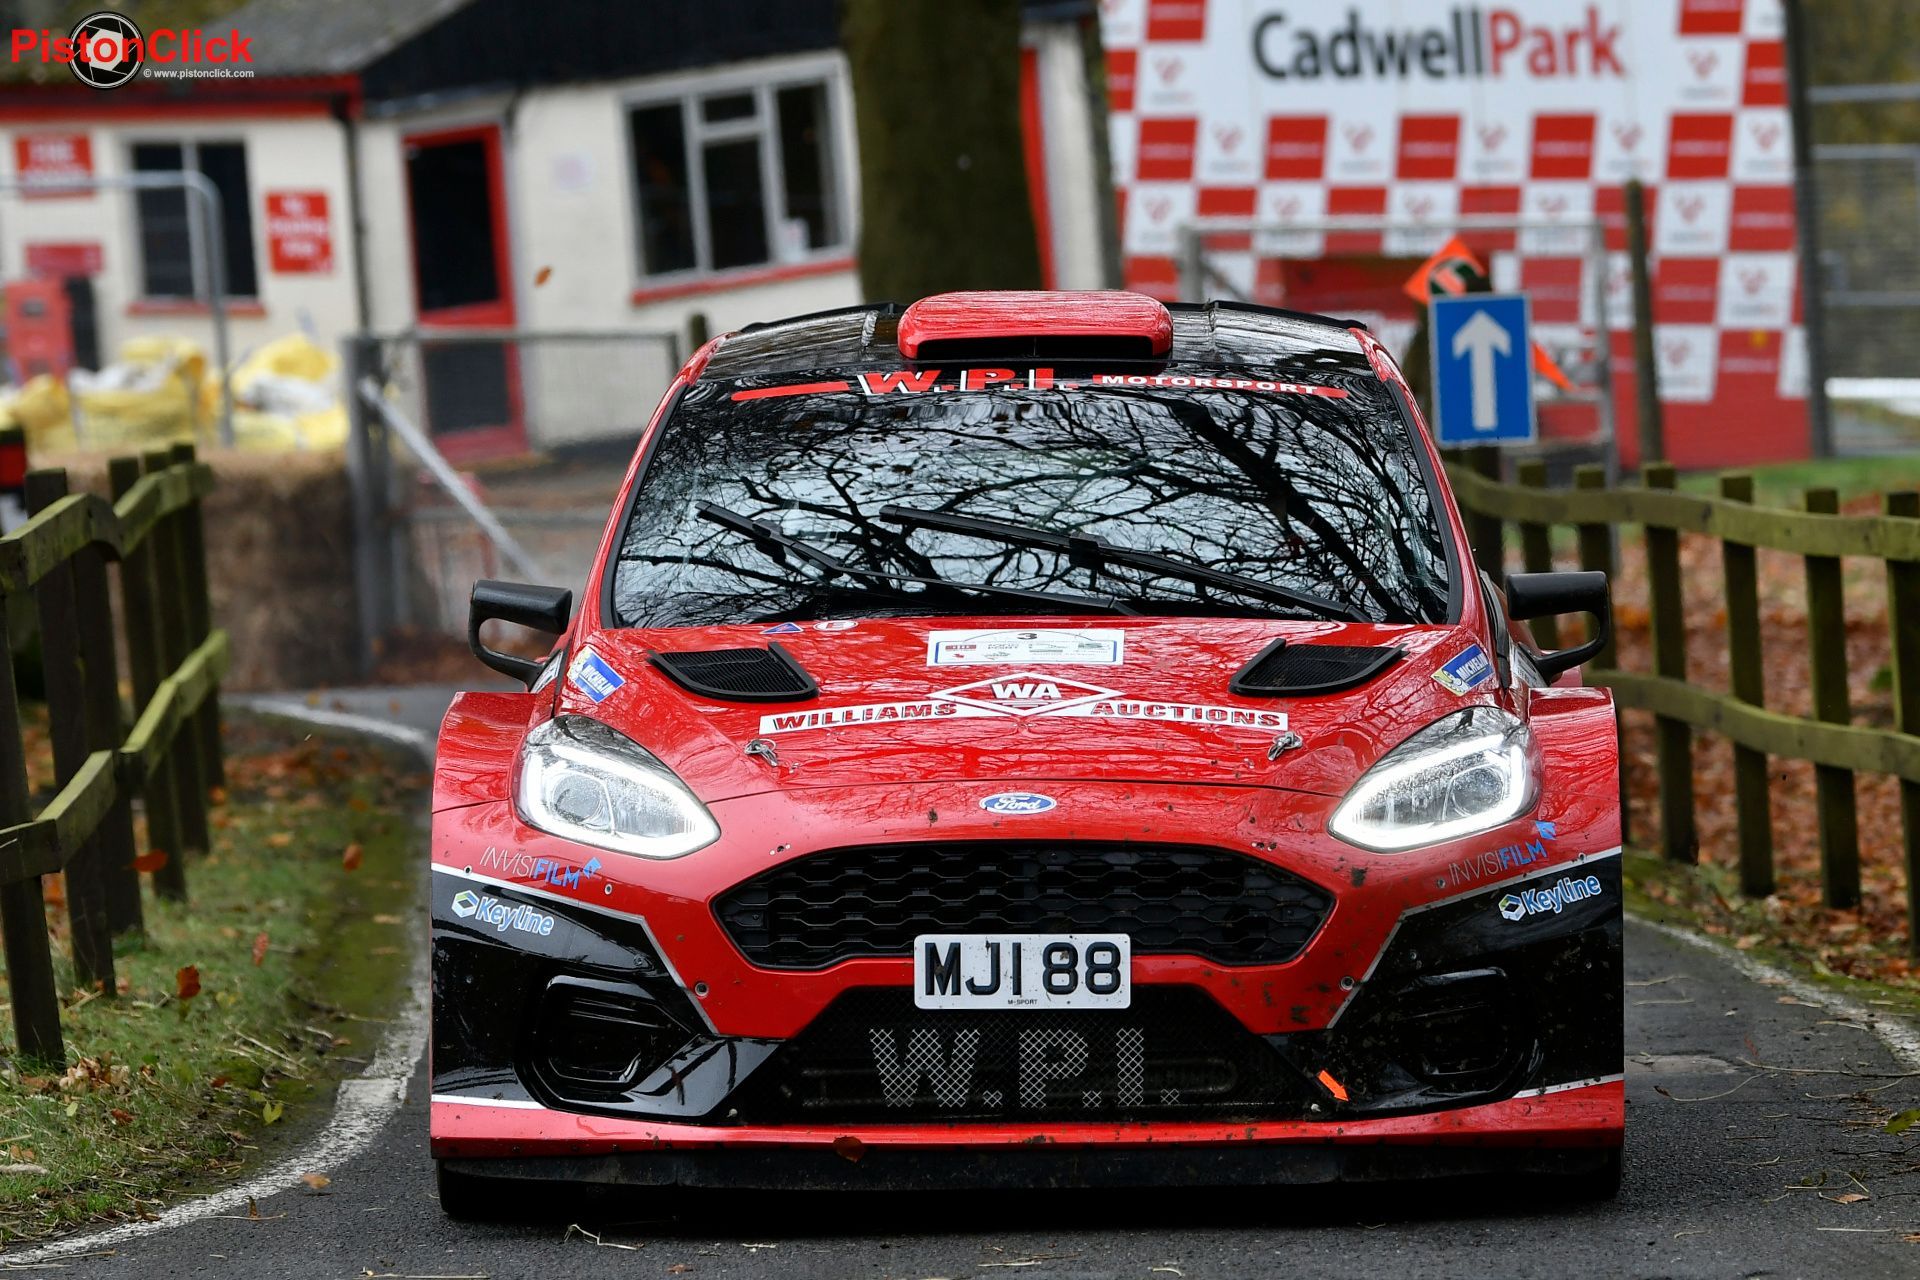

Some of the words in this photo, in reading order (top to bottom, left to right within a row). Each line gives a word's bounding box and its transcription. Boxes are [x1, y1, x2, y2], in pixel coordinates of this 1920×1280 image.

[1252, 4, 1627, 79] CadwellPark
[857, 368, 1079, 395] W.P.I.
[1102, 375, 1317, 394] MOTORSPORT
[579, 663, 617, 696] MICHELIN
[1456, 653, 1489, 681] MICHELIN
[991, 683, 1062, 699] WA
[772, 703, 957, 730] WILLIAMS
[1091, 702, 1280, 727] AUCTIONS
[994, 796, 1041, 811] Ford
[480, 846, 581, 890] INVISIFILM
[1449, 839, 1548, 886] INVISIFILM
[1521, 875, 1602, 915] Keyline
[475, 896, 555, 936] Keyline
[1042, 941, 1121, 996] 88
[868, 1028, 1180, 1108] W.P.I.
